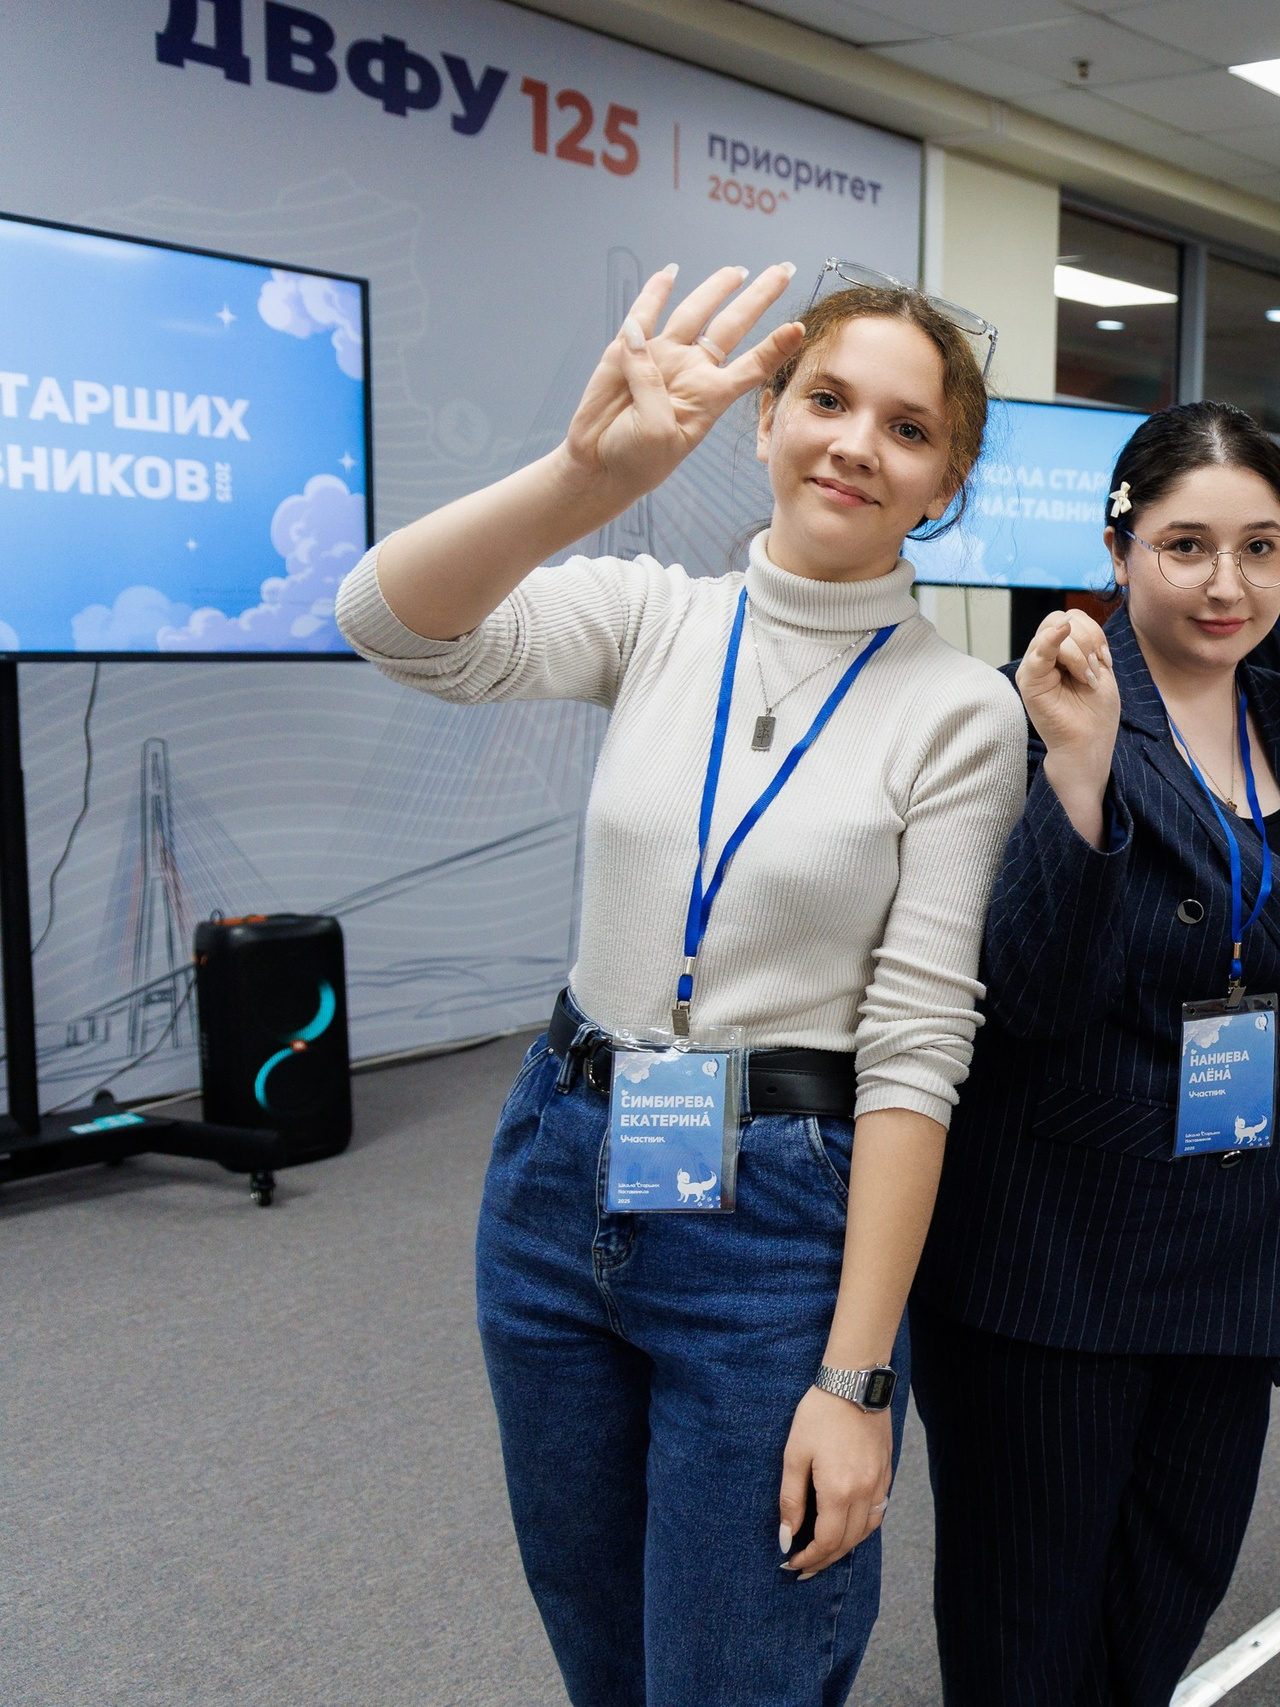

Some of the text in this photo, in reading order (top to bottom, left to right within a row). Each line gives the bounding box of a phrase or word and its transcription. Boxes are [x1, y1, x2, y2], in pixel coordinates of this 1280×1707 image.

[155, 0, 640, 177] ДВФУ 125
[708, 132, 883, 206] приоритет
[0, 443, 211, 502] НИКОВ
[1049, 467, 1112, 493] СТАР
[1190, 1050, 1250, 1067] НАНИЕВА
[1189, 1067, 1232, 1084] АЛЁНА
[621, 1095, 715, 1108] СИМБИРЕВА
[620, 1114, 711, 1127] ЕКАТЕРИНА
